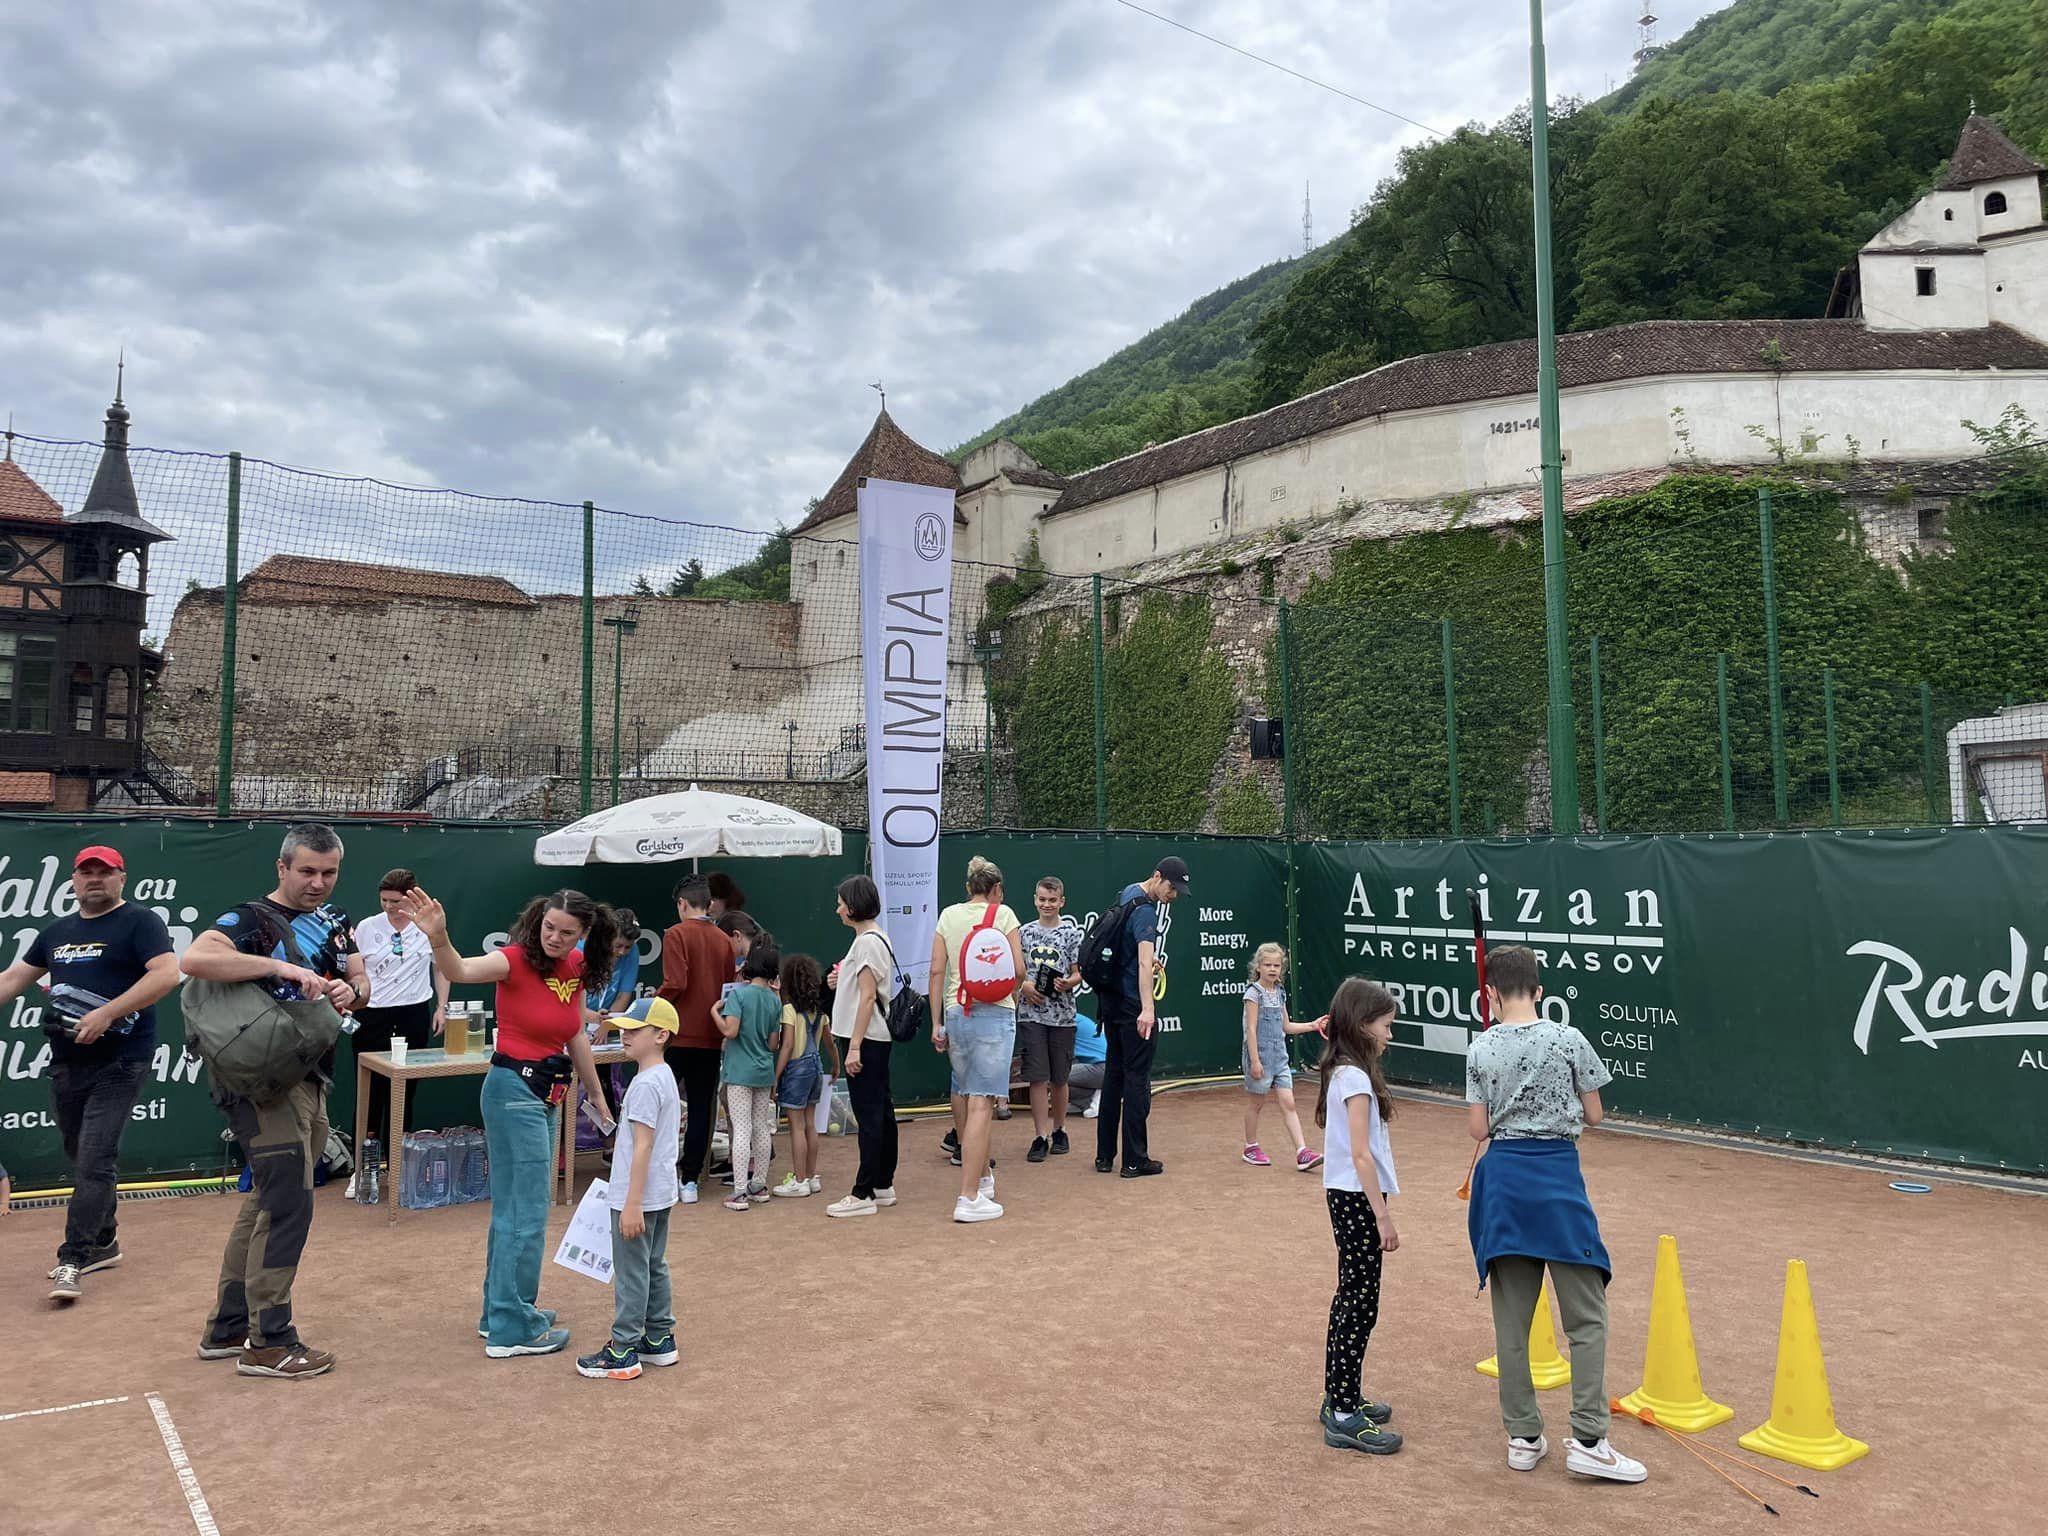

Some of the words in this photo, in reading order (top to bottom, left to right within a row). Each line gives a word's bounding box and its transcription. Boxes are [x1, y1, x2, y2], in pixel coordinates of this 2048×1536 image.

[1490, 416, 1540, 435] 1421-14
[882, 587, 944, 848] OLIMPIA
[636, 836, 684, 857] Carlsberg
[134, 878, 177, 900] cu
[1344, 871, 1663, 928] Artizan
[1199, 907, 1233, 921] More
[1199, 931, 1249, 949] Energy,
[1200, 956, 1235, 971] More
[1344, 938, 1477, 963] PARCHET
[1532, 949, 1663, 975] RASOV
[9, 995, 43, 1029] la
[1600, 1031, 1653, 1051] CASEI
[522, 1066, 533, 1077] EC
[1601, 1058, 1647, 1079] TALE
